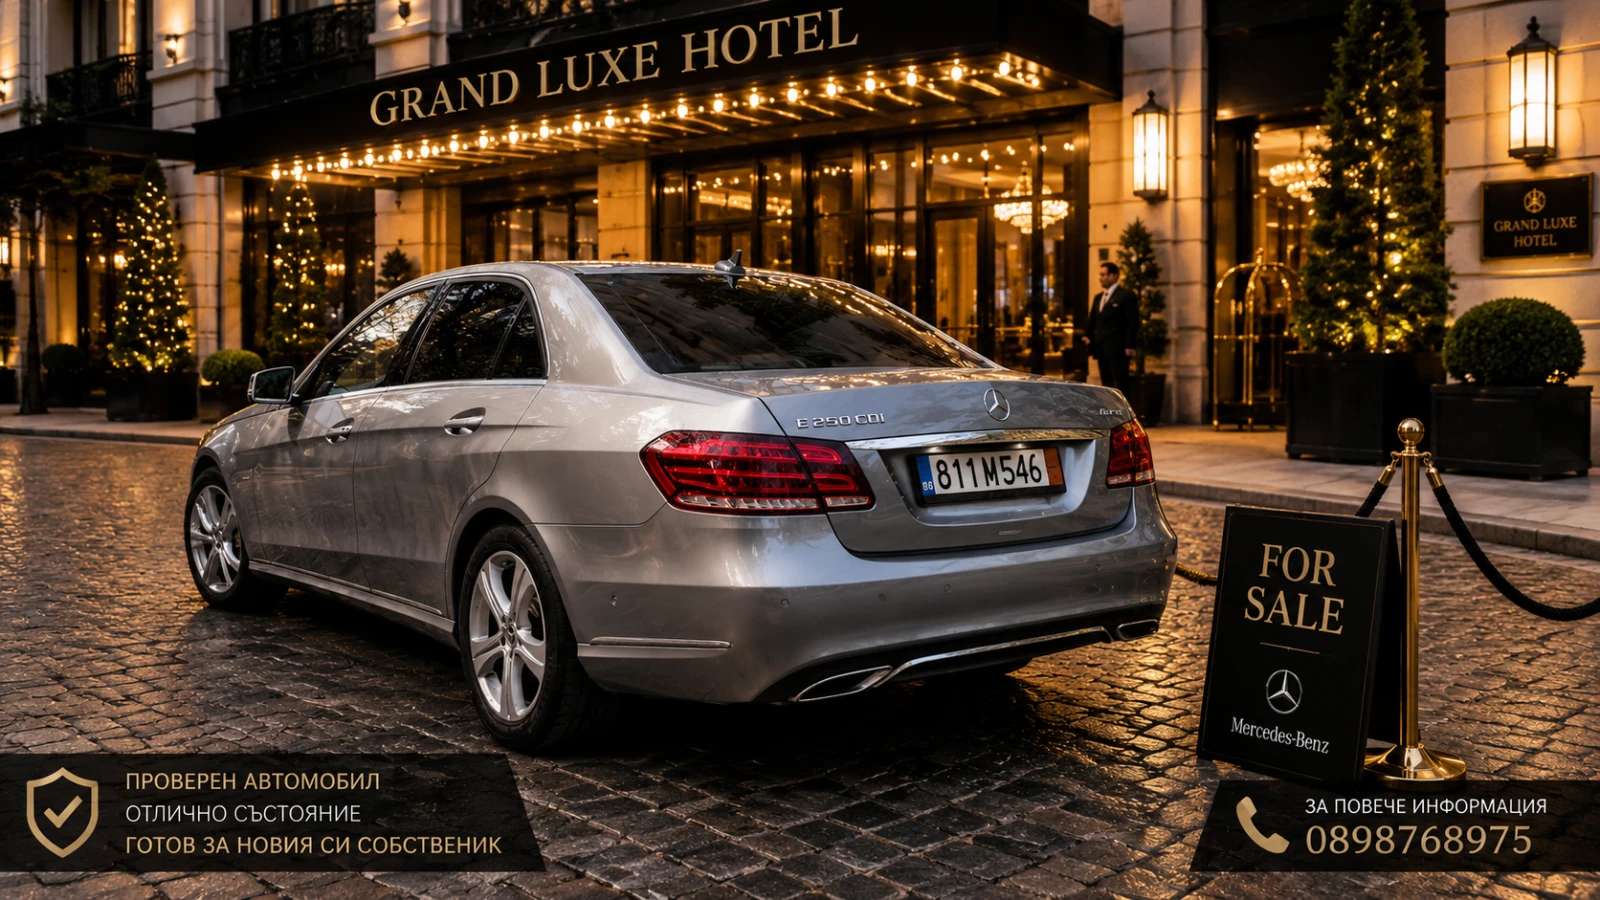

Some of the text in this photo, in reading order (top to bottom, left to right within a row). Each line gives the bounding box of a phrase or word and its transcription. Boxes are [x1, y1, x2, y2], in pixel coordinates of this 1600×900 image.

[370, 7, 860, 127] GRAND LUXE HOTEL
[1493, 216, 1577, 233] GRAND LUXE
[1514, 234, 1557, 248] HOTEL
[796, 413, 885, 429] E 250 CDI
[936, 453, 1042, 489] 811M546
[1259, 543, 1337, 587] FOR
[1244, 586, 1345, 635] SALE
[1231, 716, 1330, 754] Mercedes-Benz
